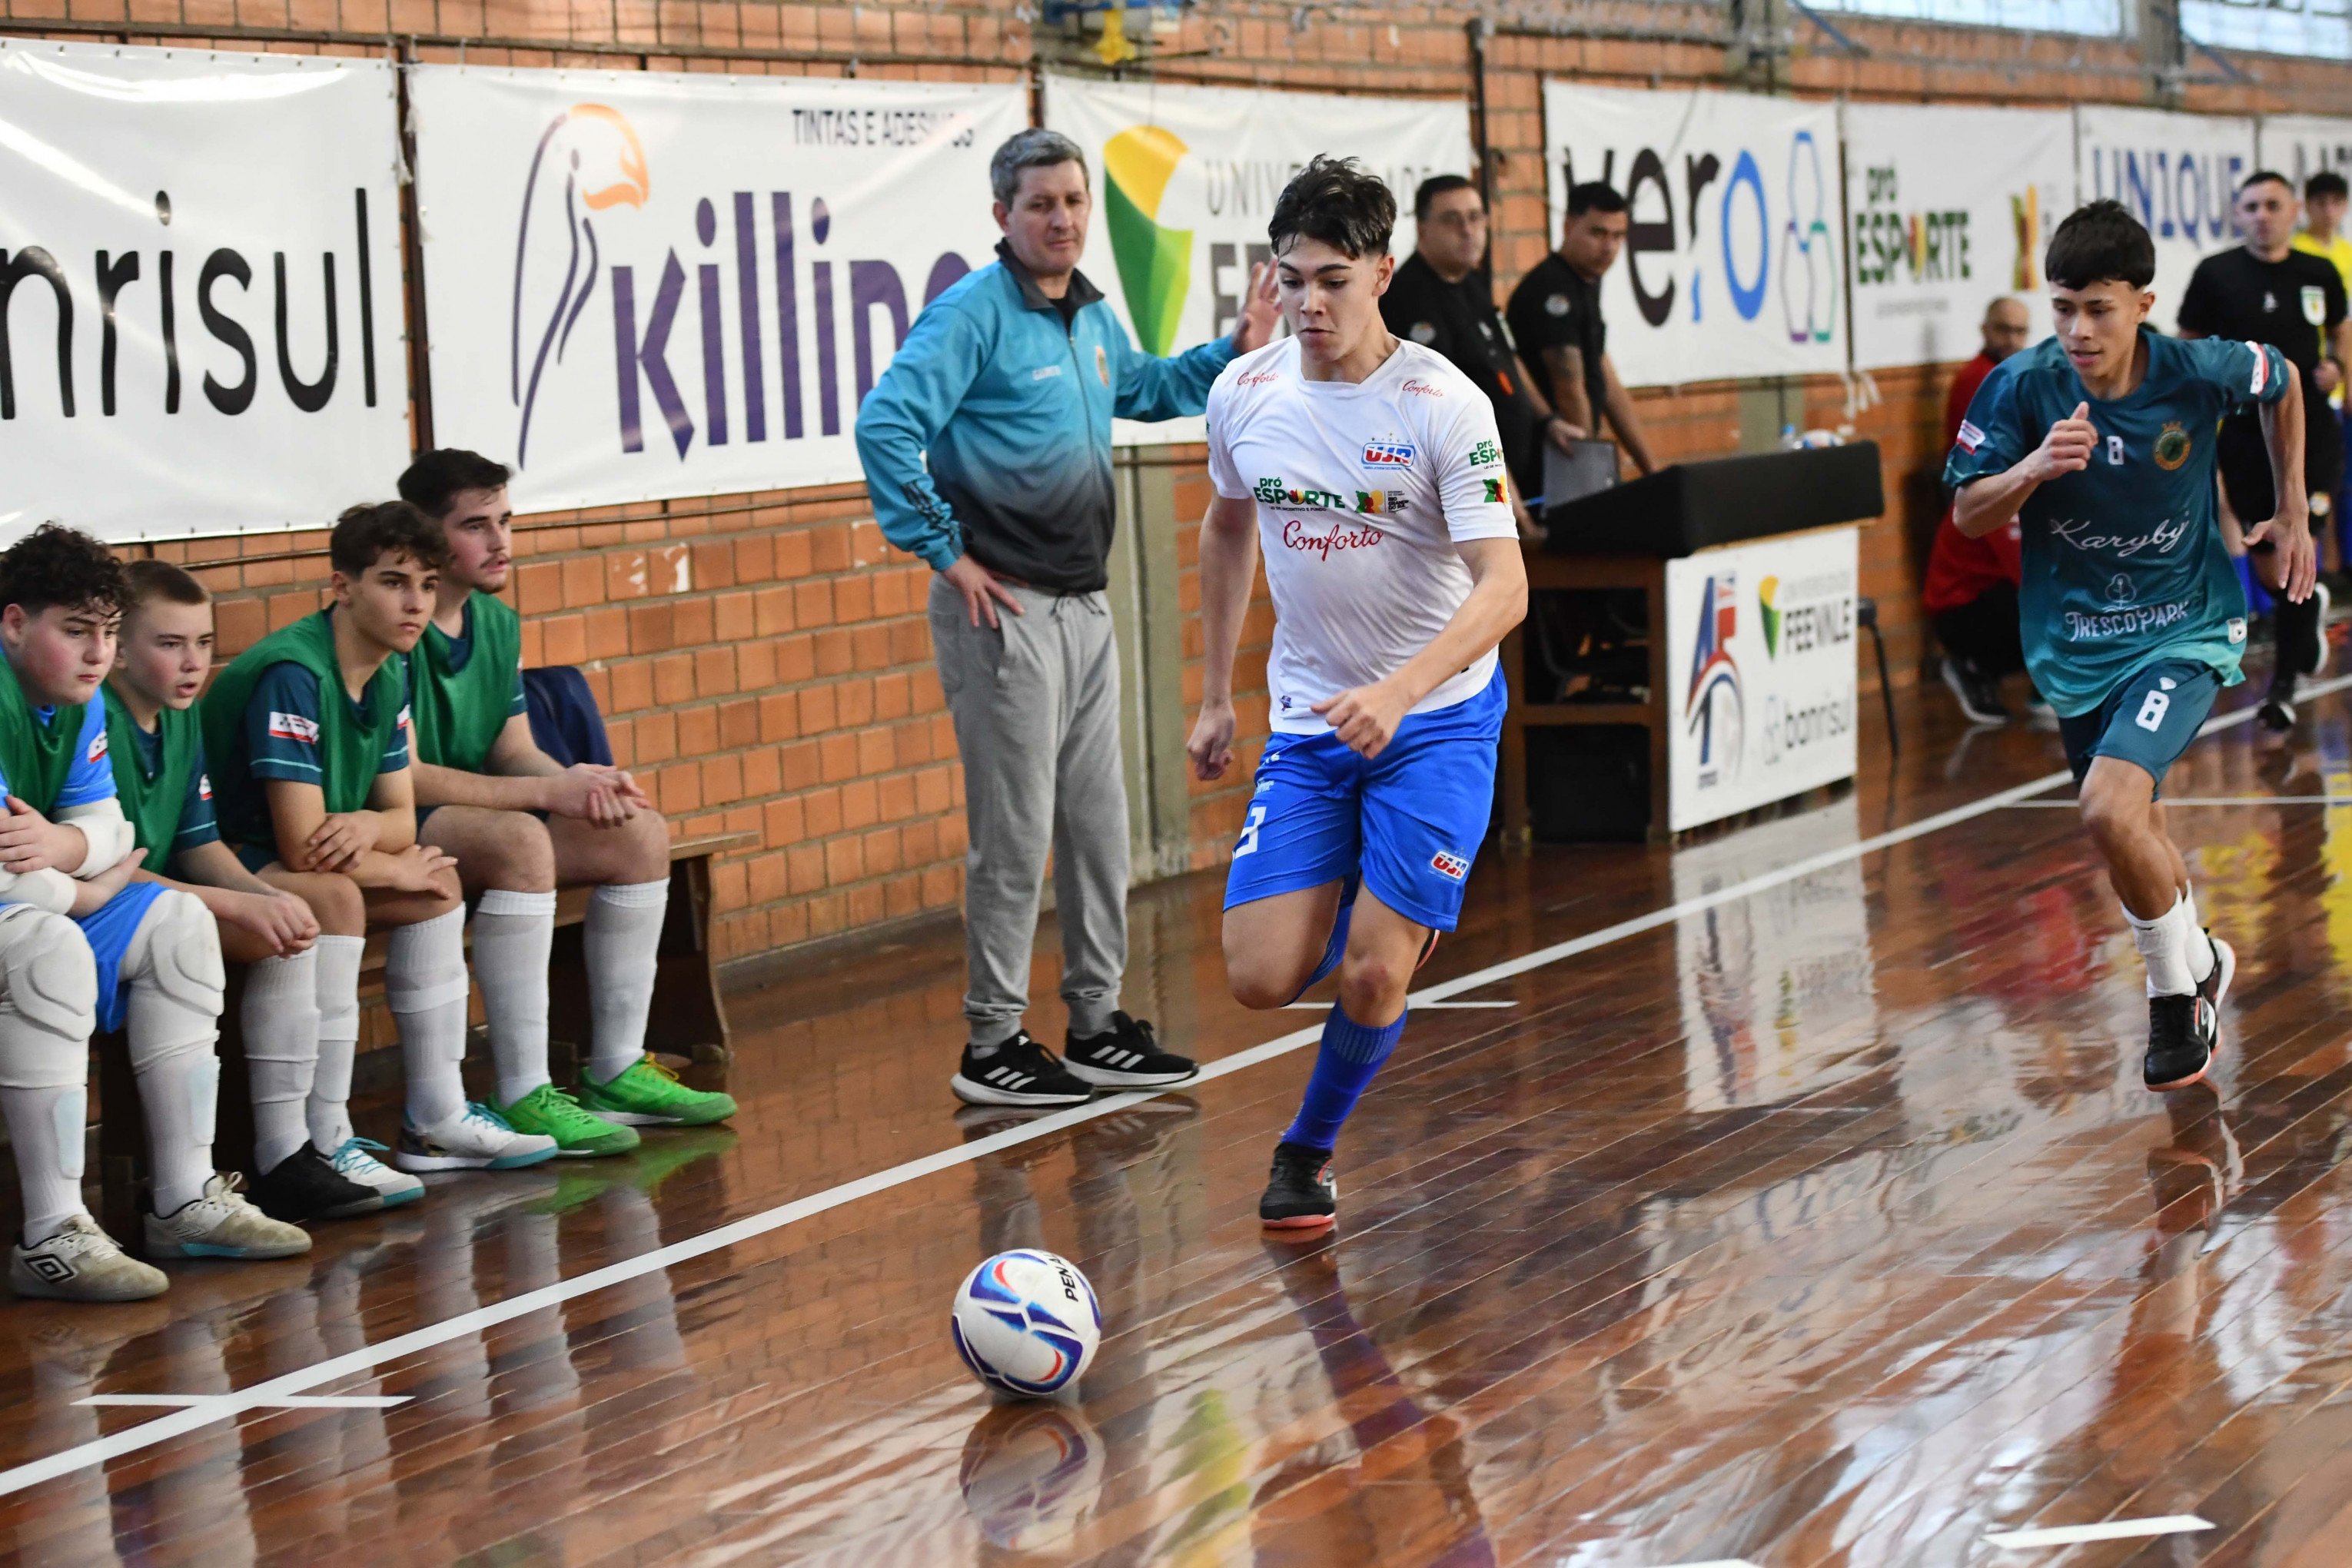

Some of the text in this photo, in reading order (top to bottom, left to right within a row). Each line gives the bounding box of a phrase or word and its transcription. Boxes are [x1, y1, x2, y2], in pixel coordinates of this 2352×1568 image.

[792, 109, 974, 147] TINTAS E ADESOS
[1563, 145, 1768, 328] ero
[1856, 211, 1971, 285] ESPORTE
[1403, 380, 1444, 398] Conforto
[1476, 437, 1493, 451] pró
[2107, 435, 2124, 465] 8
[1253, 487, 1346, 509] ESPORTE
[1259, 477, 1282, 488] pró
[1283, 520, 1384, 562] Conforto
[2135, 689, 2170, 732] 8
